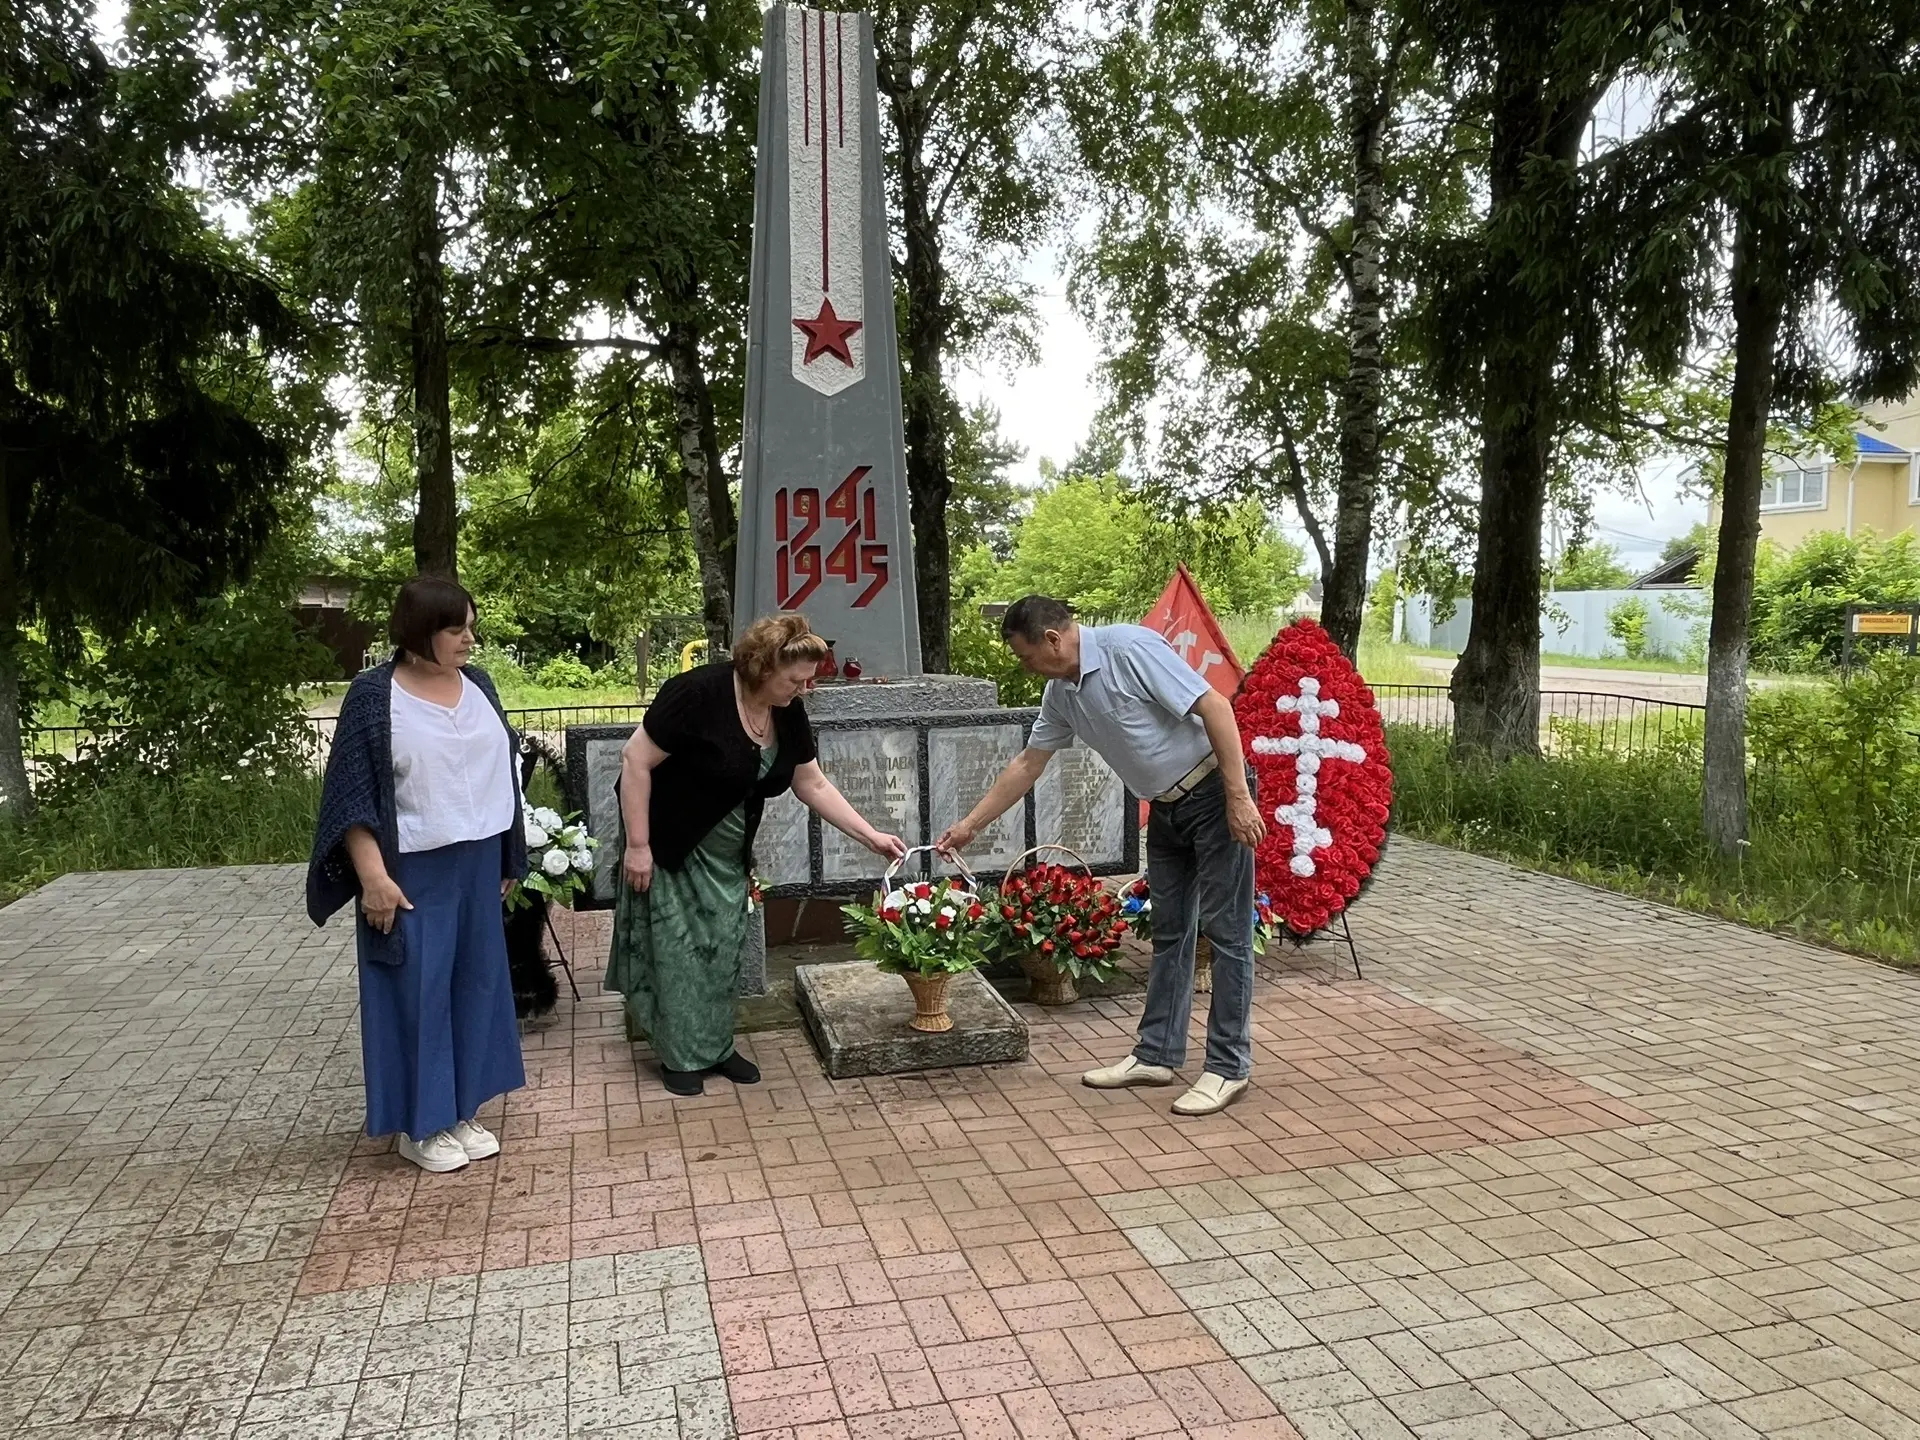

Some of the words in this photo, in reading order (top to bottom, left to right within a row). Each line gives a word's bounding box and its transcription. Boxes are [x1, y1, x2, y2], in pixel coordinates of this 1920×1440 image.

[775, 465, 876, 556] 1941
[776, 519, 889, 610] 1945
[842, 775, 897, 790] ВОИНАМ
